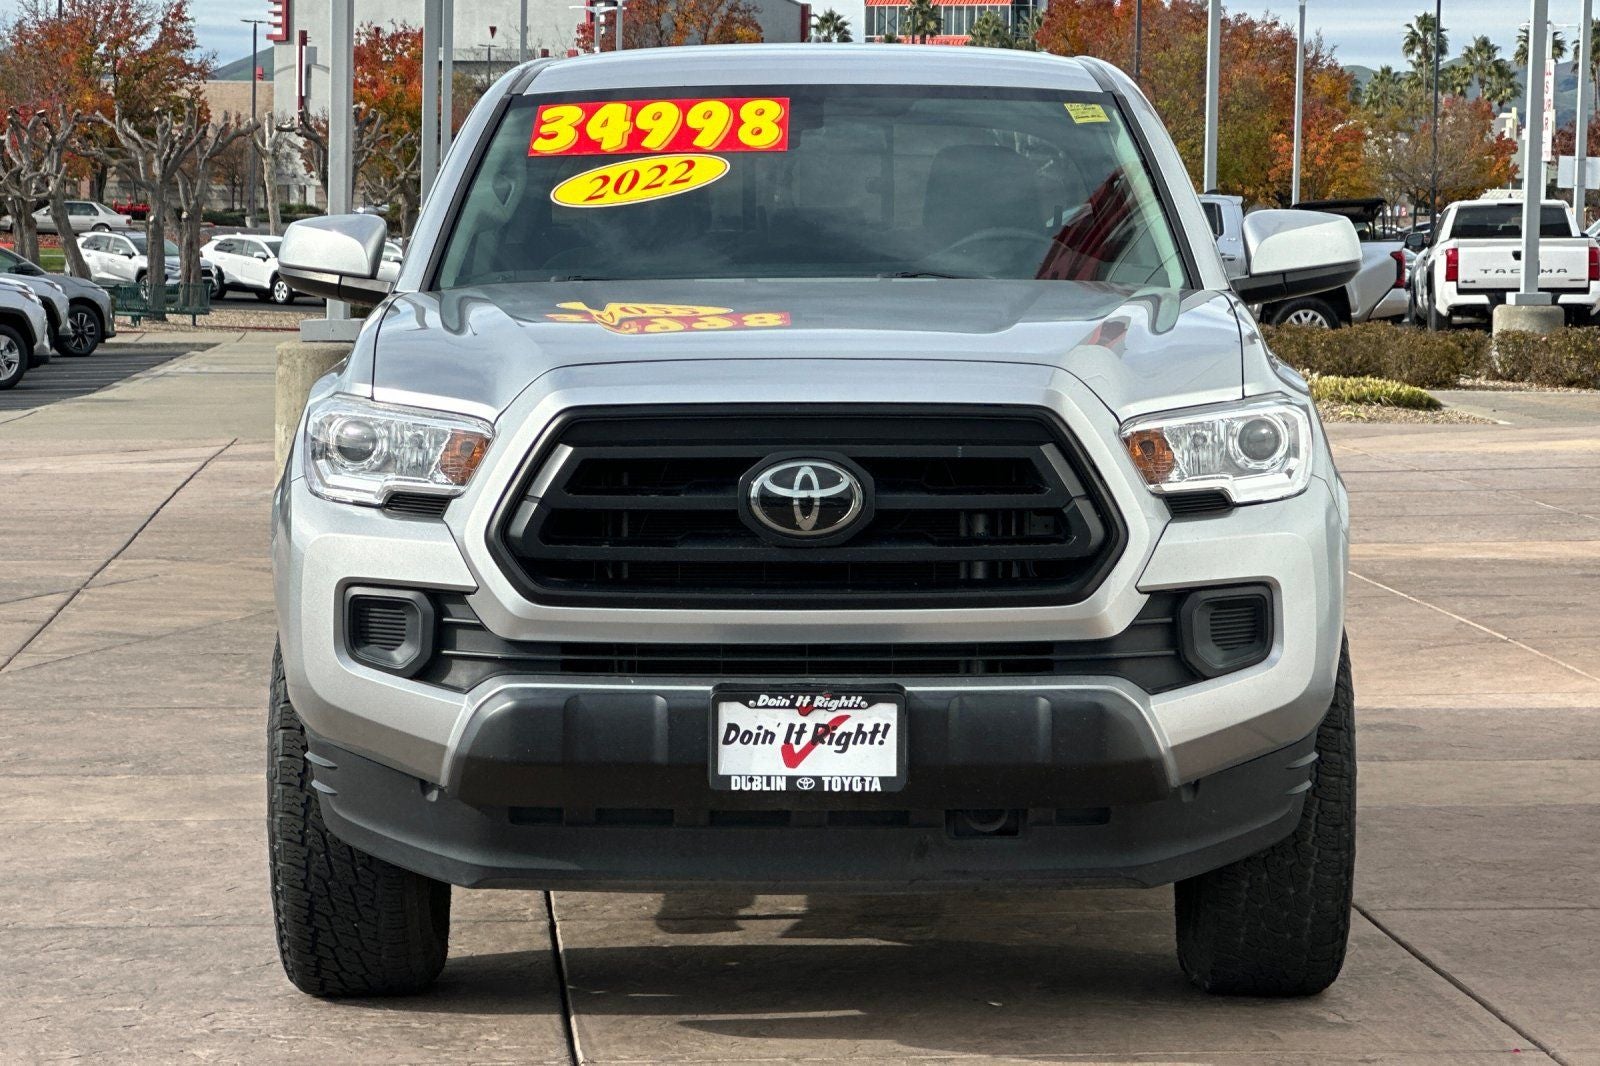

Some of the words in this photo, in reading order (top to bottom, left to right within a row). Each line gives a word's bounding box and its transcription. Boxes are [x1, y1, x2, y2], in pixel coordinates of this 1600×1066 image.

[531, 99, 785, 154] 34998
[582, 159, 696, 202] 2022
[757, 694, 795, 707] Doin'
[796, 694, 811, 707] It
[813, 694, 863, 712] Right!
[722, 722, 781, 746] Doin'
[783, 722, 807, 746] It
[811, 722, 891, 753] Right!
[731, 775, 787, 791] DUBLIN
[821, 776, 882, 792] TOYOTA
